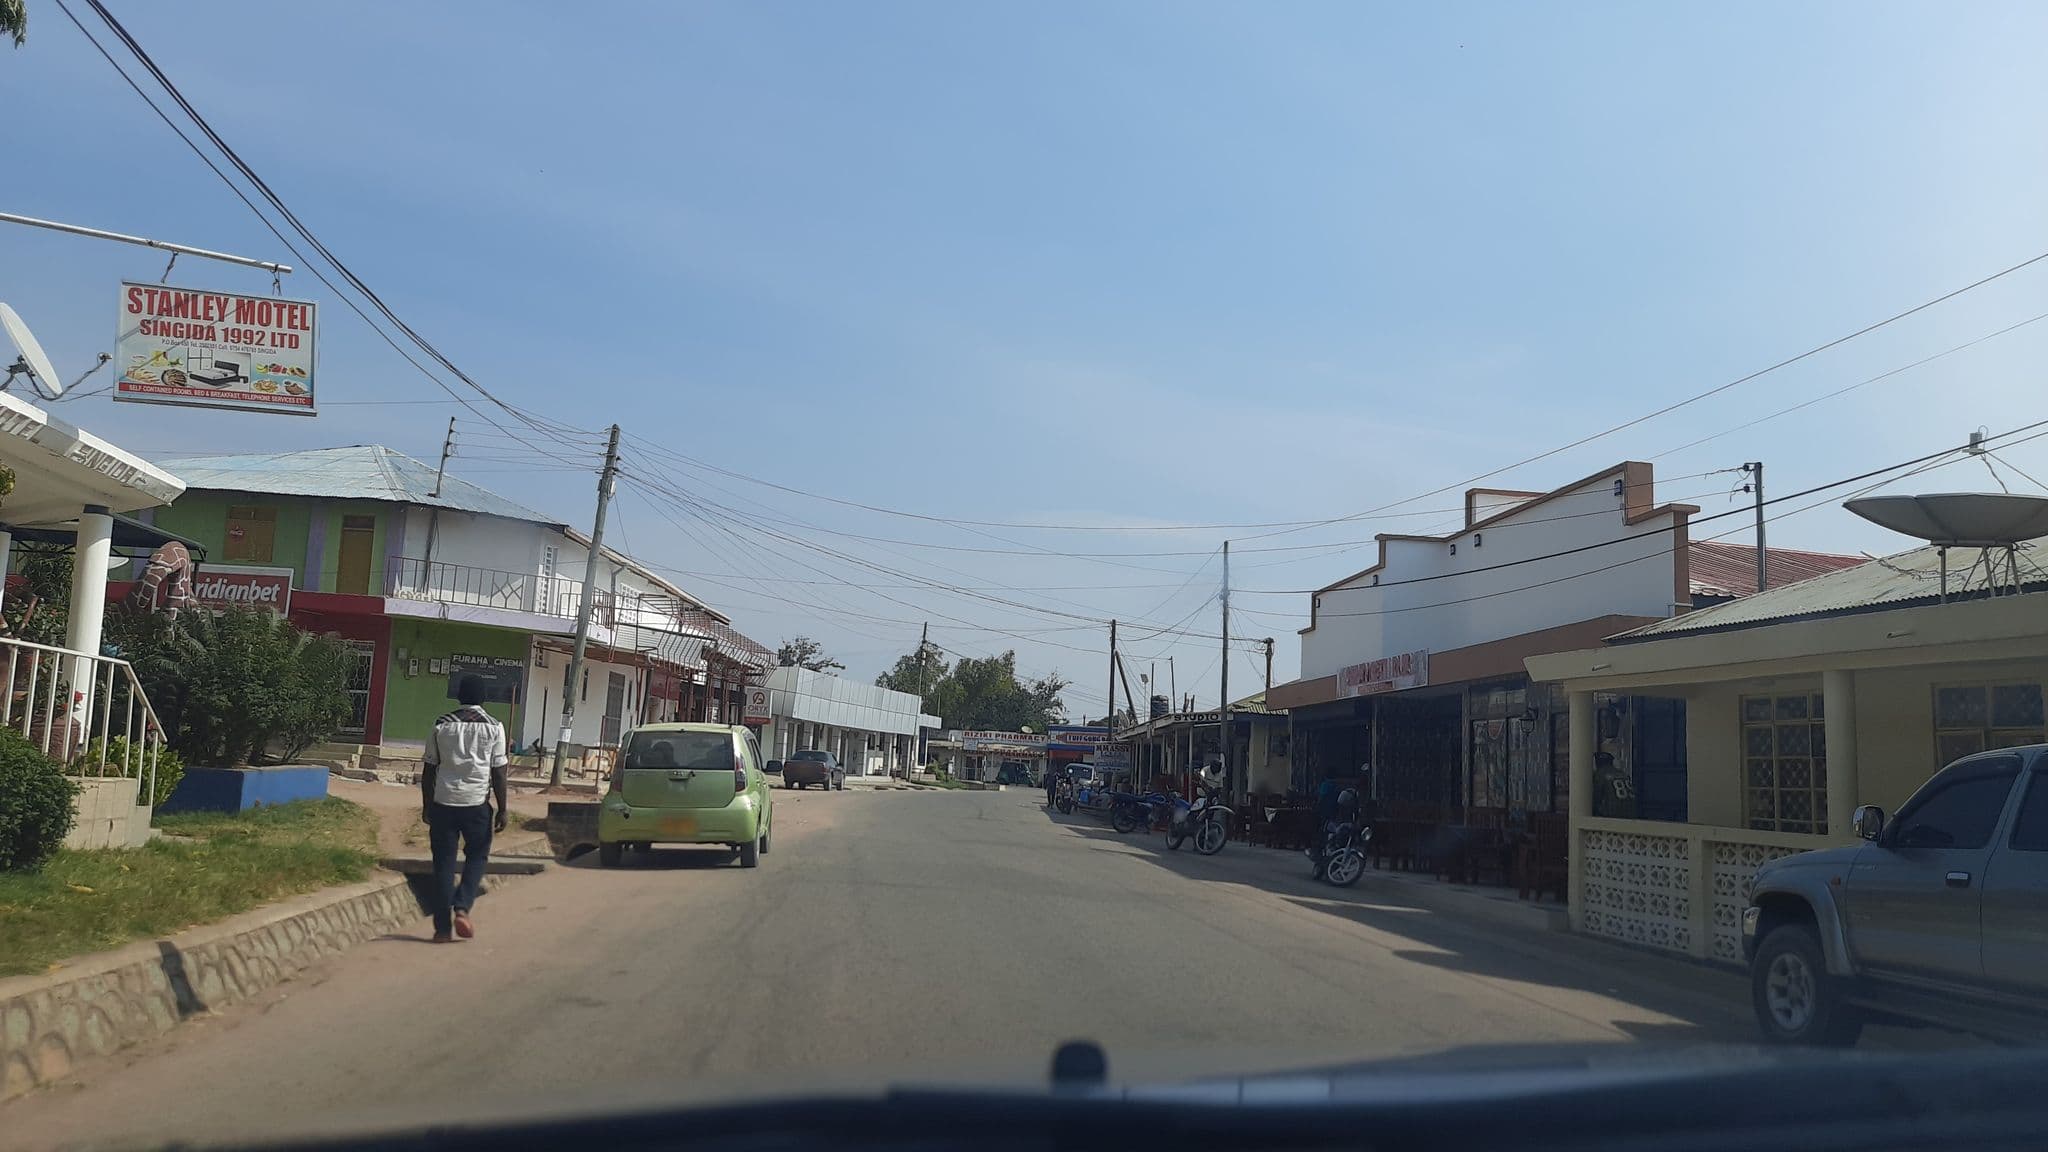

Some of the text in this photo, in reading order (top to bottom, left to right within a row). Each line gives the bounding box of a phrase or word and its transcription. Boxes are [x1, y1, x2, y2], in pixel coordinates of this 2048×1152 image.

[128, 287, 310, 331] STANLEY MOTEL
[139, 319, 300, 349] SINGIDA 1992 LTD
[143, 385, 172, 394] CONTAINED
[242, 394, 271, 402] TELEPHONE
[195, 577, 280, 602] ridianbet
[453, 655, 488, 665] FURAHA
[494, 658, 523, 667] CINEMA
[1174, 713, 1218, 721] STUDIO
[995, 733, 1046, 742] PHARMACY
